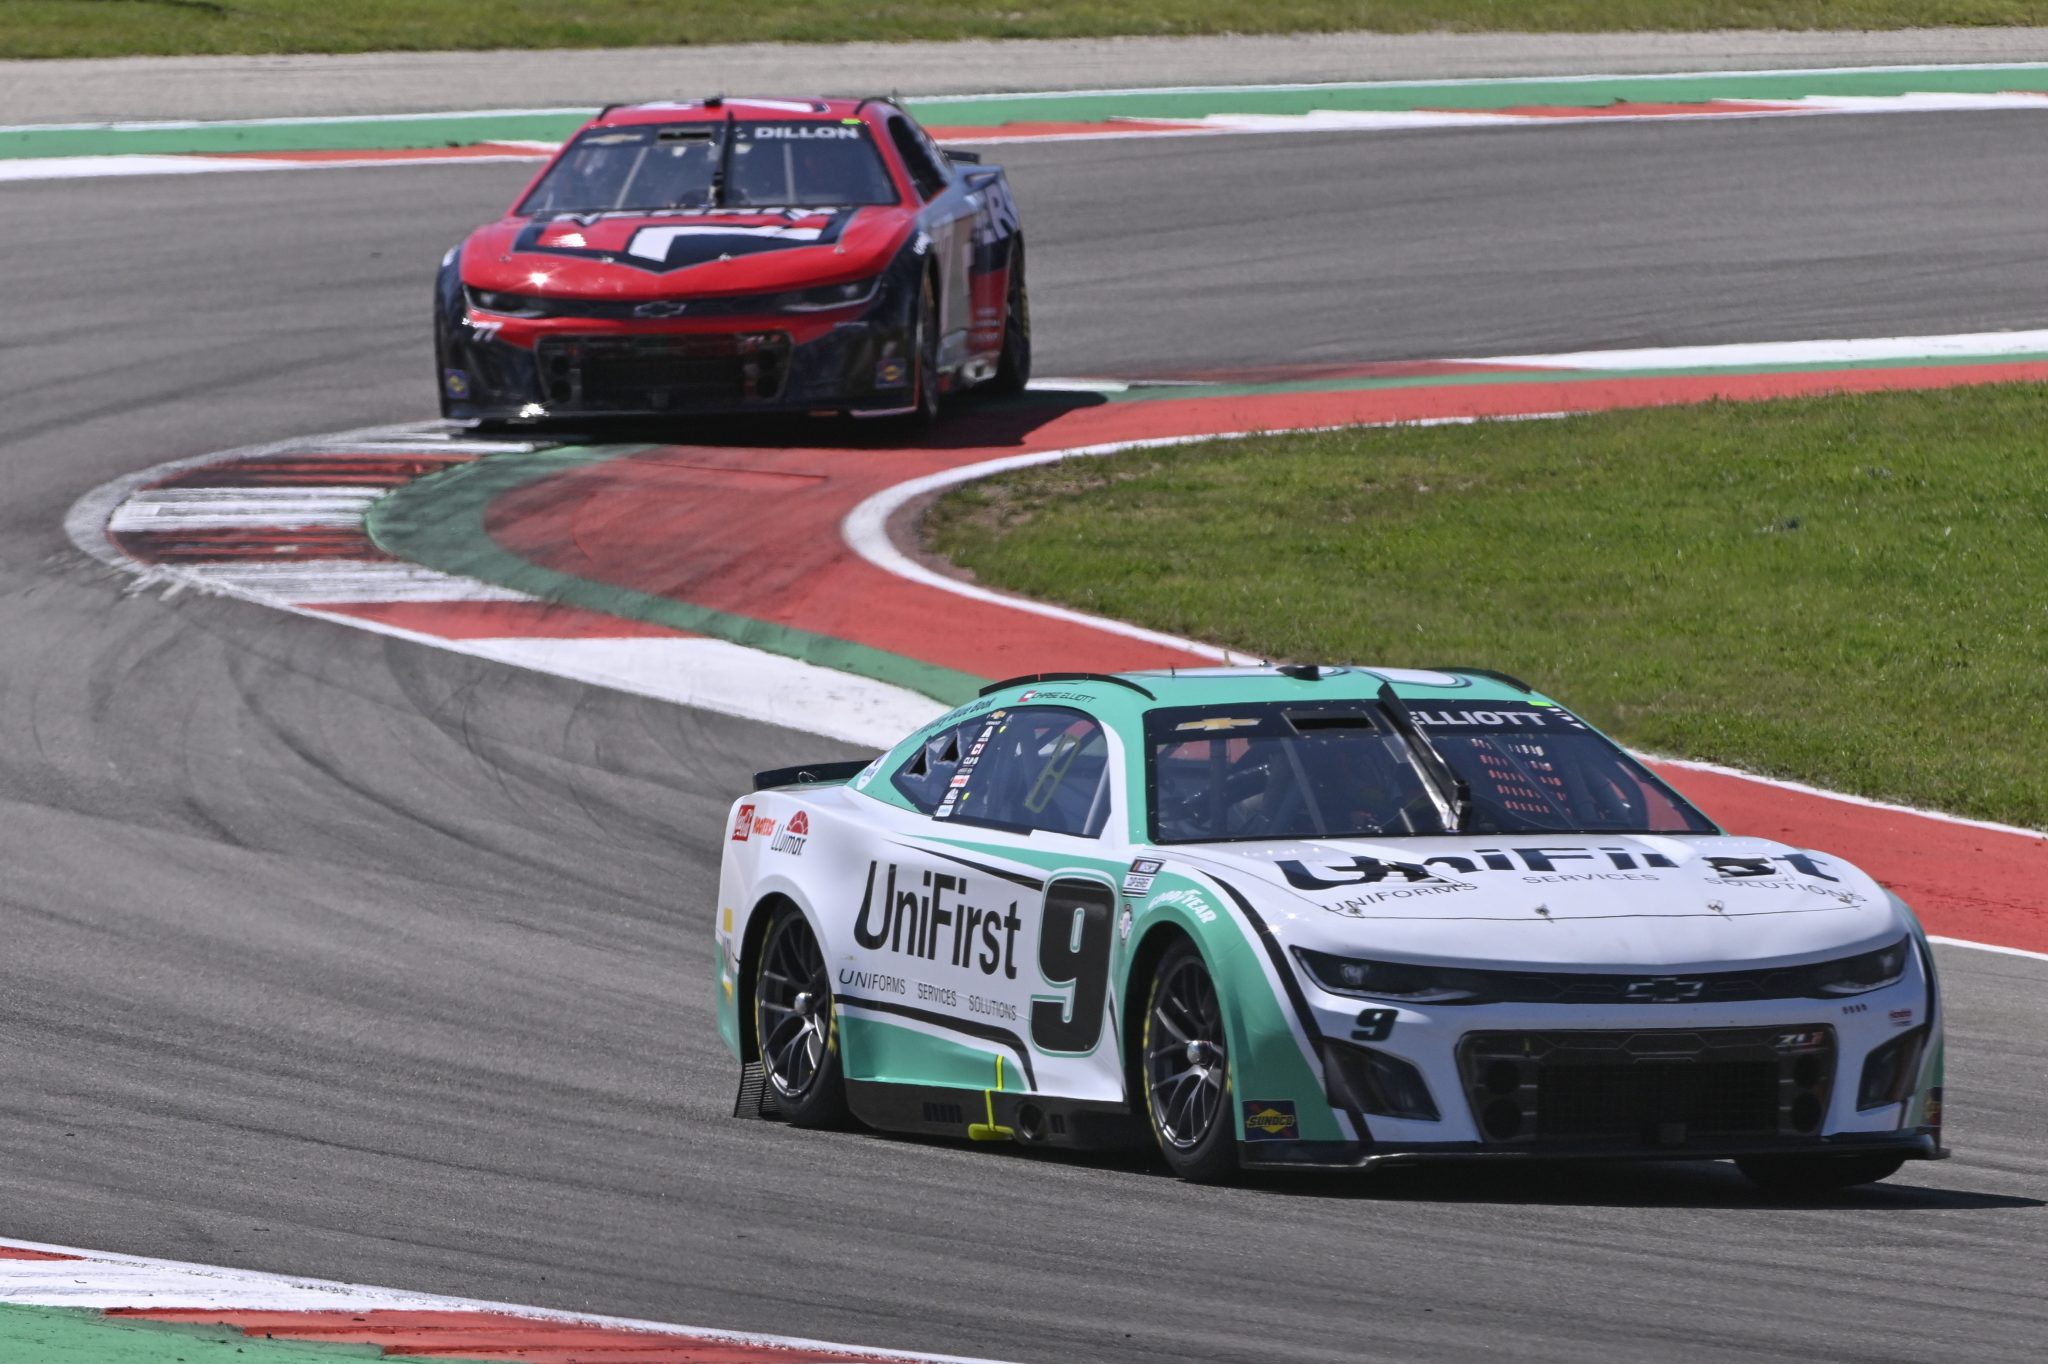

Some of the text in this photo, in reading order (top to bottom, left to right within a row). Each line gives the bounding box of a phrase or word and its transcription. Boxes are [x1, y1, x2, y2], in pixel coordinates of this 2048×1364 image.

[754, 126, 859, 140] DILLON
[1060, 692, 1097, 703] ELLIOTT
[1321, 873, 1867, 912] UNIFORMS SERVICES SOLUTIONS
[853, 860, 1022, 980] UniFirst
[1030, 868, 1117, 1057] 9
[838, 968, 1017, 1021] UNIFORMS SERVICES SOLUTIONS
[1351, 1008, 1399, 1042] 9
[1246, 1114, 1296, 1129] SUNOCO
